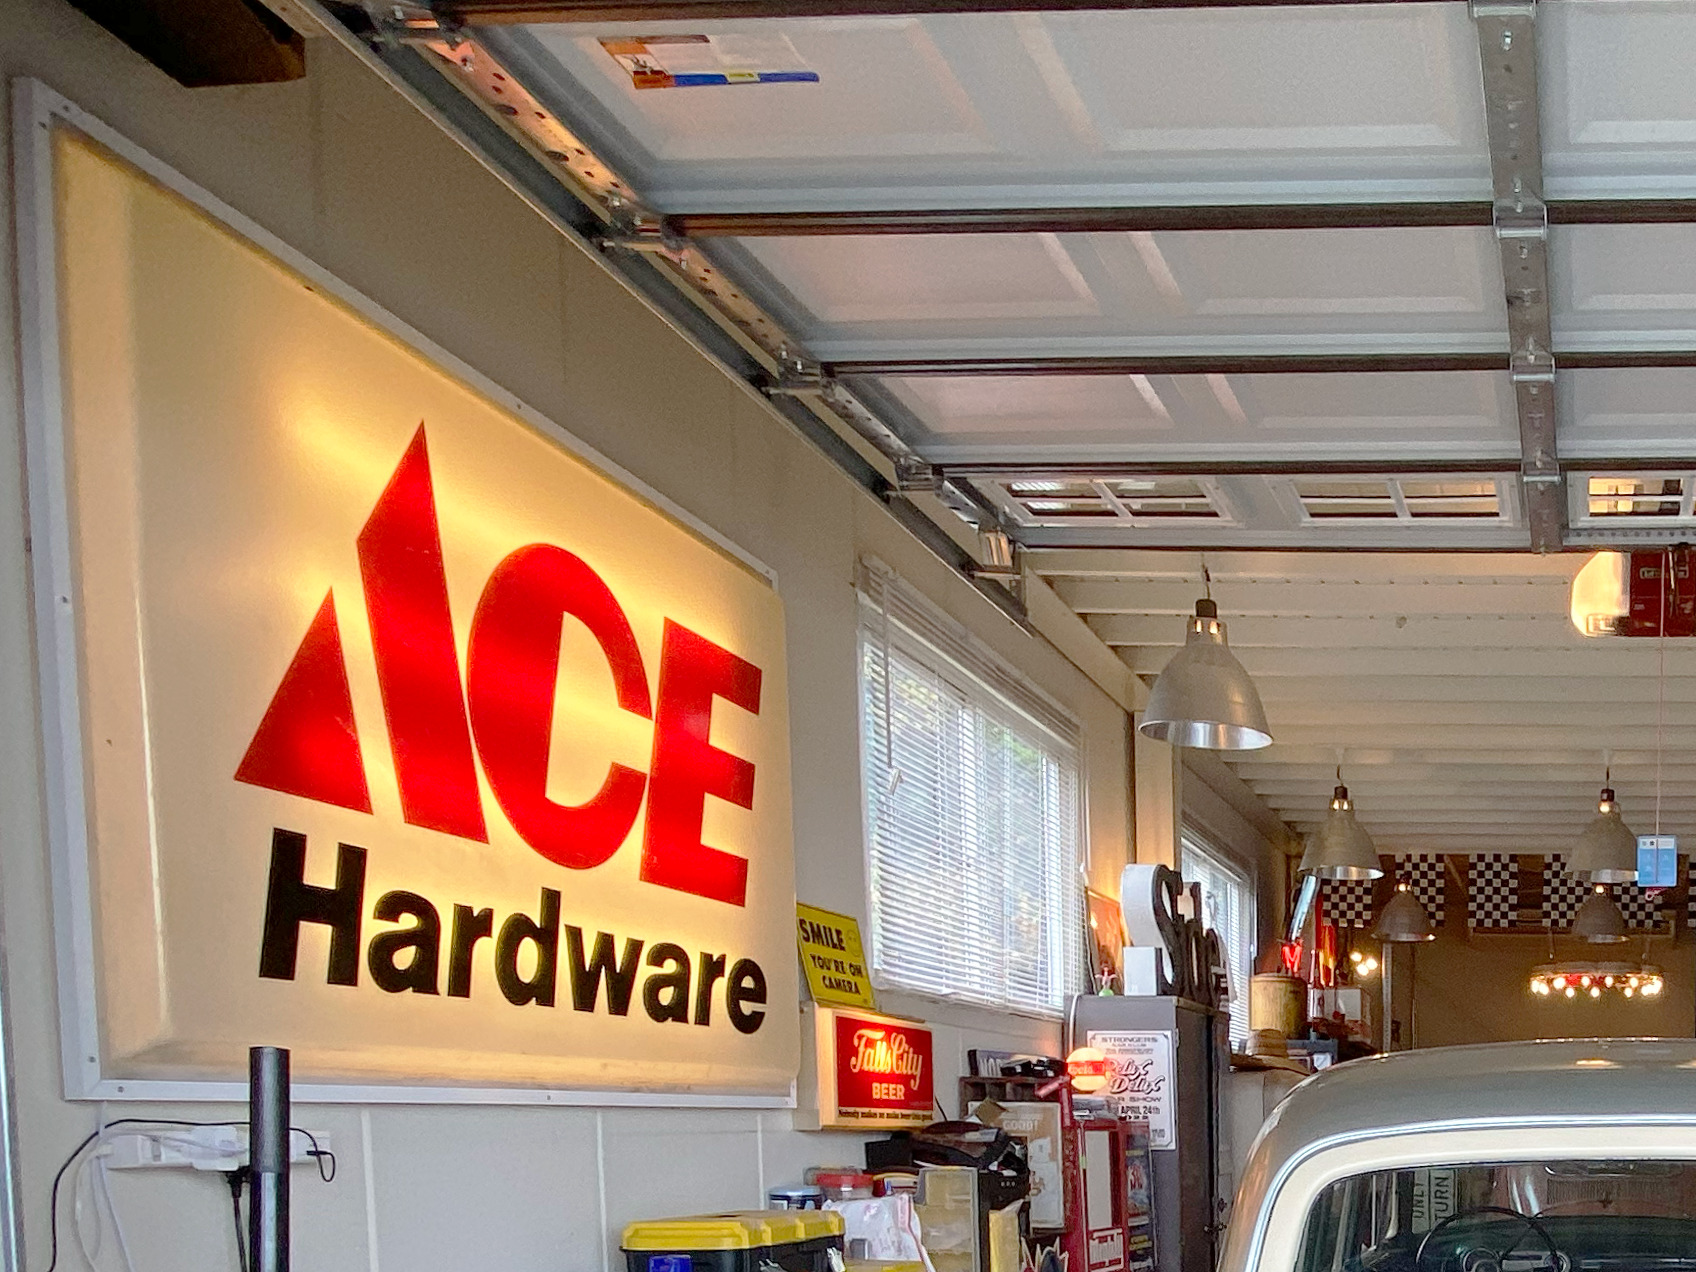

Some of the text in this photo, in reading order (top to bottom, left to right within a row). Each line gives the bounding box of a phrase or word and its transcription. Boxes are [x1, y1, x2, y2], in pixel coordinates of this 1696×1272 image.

[234, 419, 763, 908] ACE
[259, 827, 768, 1035] Hardware
[799, 918, 846, 951] SMILE
[810, 953, 864, 978] YOU'RE ON
[822, 975, 861, 996] CAMERA
[850, 1028, 922, 1090] Falls City
[872, 1082, 905, 1100] BEER
[1120, 1105, 1142, 1115] APRIL
[1433, 1176, 1450, 1222] TURN
